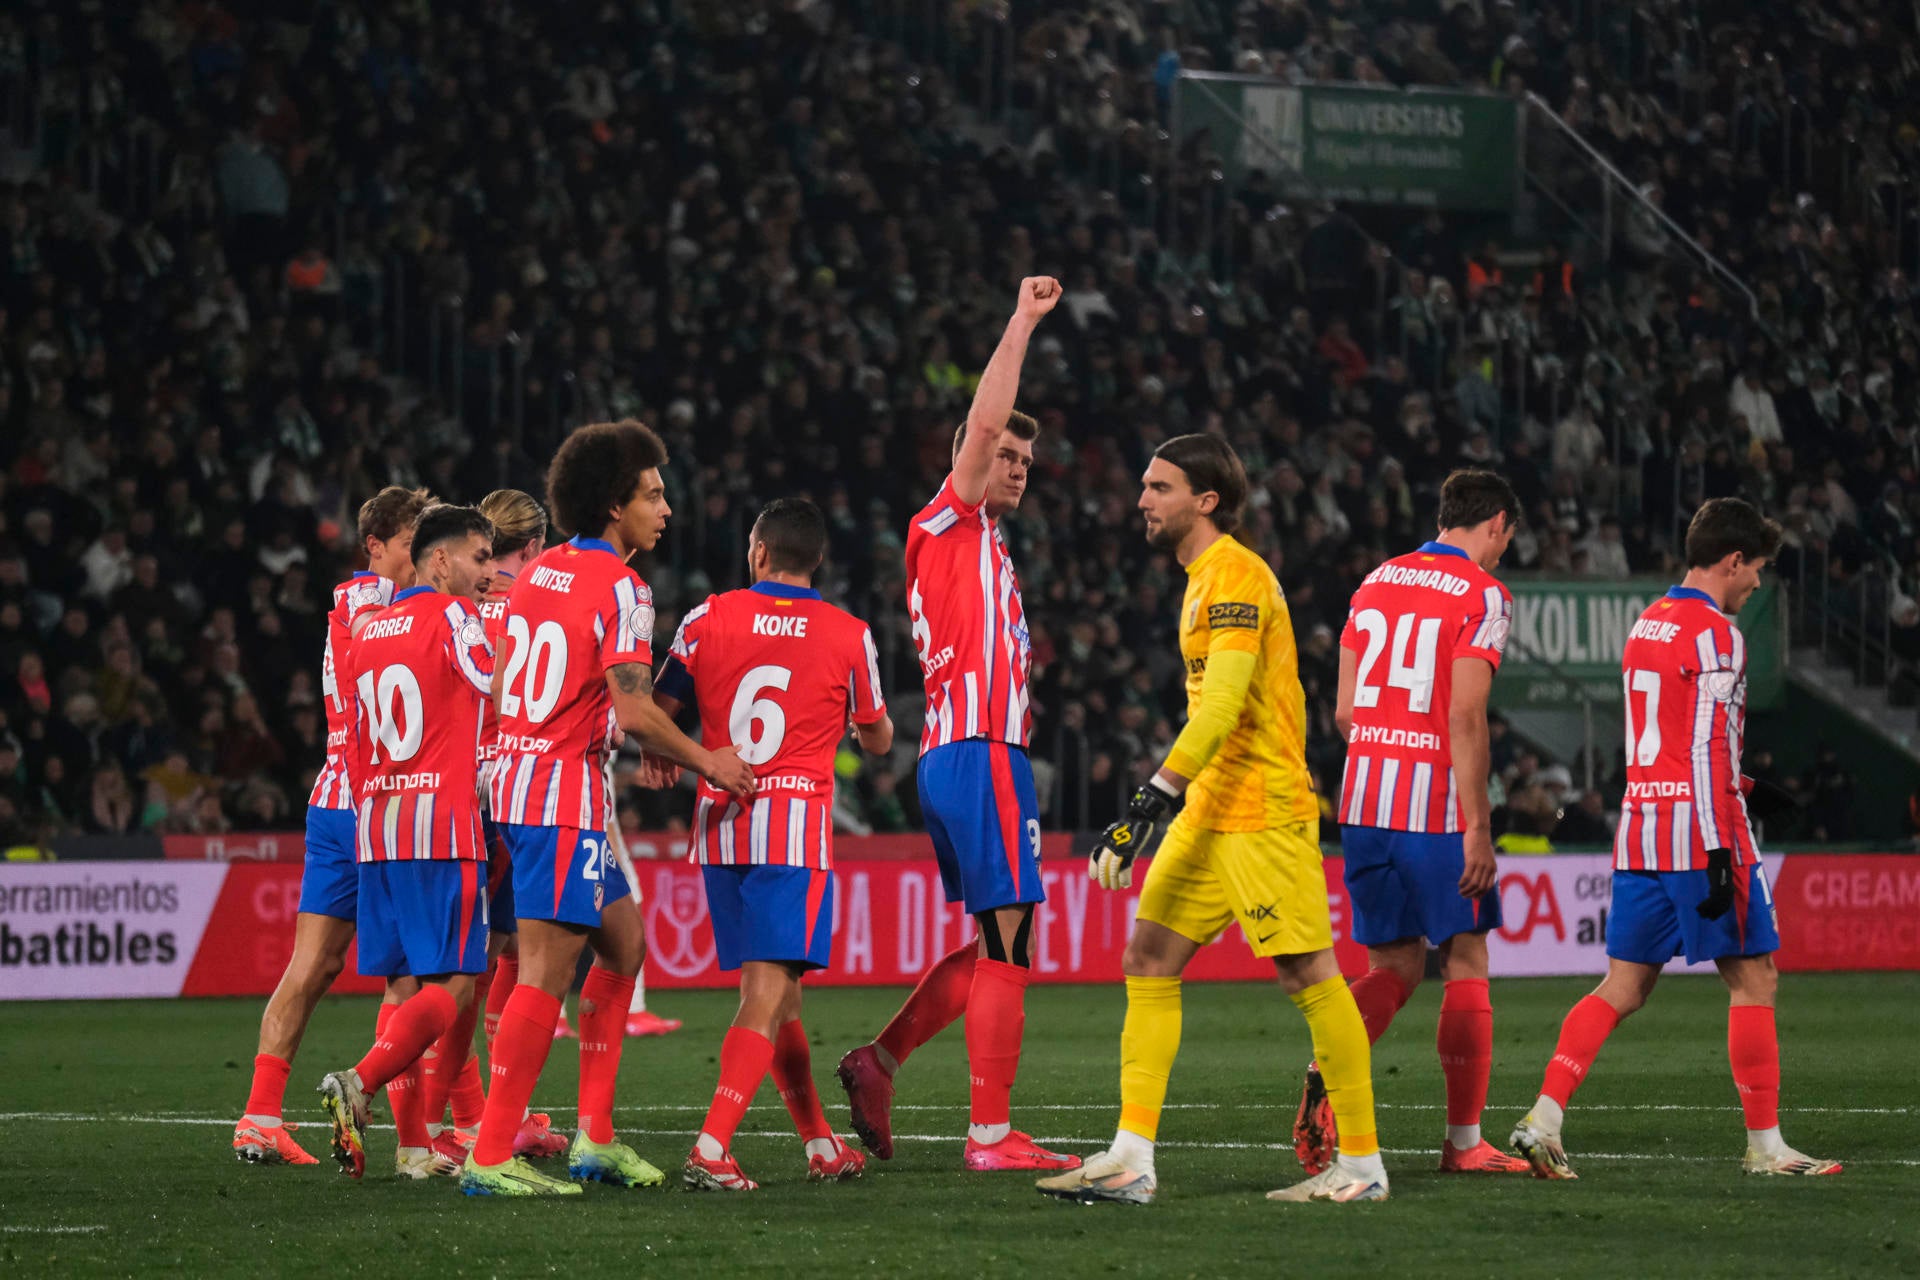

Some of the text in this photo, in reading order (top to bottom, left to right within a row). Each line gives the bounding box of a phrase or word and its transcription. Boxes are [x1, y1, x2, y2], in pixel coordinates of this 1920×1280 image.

[1311, 101, 1465, 138] UNIVERSITAS
[529, 565, 576, 594] WITSEL
[1381, 564, 1470, 597] NORMAND
[362, 616, 414, 641] CORREA
[752, 614, 808, 638] KOKE
[500, 614, 567, 723] 20
[1353, 608, 1442, 714] 24
[356, 663, 424, 766] 10
[728, 664, 792, 766] 6
[1361, 726, 1440, 750] HYUNDAI
[1027, 818, 1041, 858] 9
